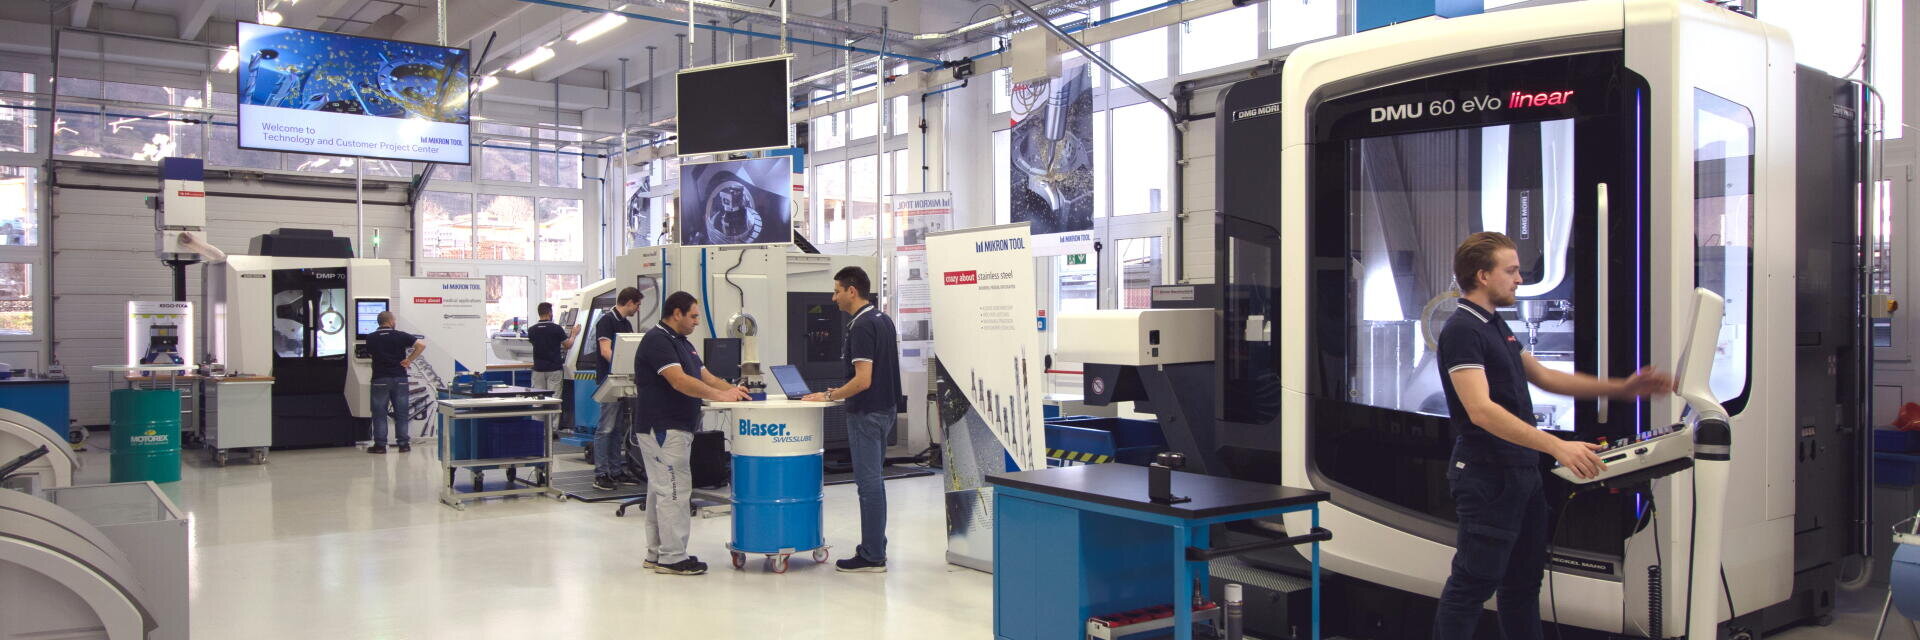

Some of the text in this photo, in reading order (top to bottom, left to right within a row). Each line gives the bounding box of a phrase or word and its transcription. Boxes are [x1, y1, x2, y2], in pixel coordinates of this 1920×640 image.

[1238, 105, 1280, 118] DMG MORI
[1371, 90, 1574, 123] DMU 60 eVo linear
[261, 122, 316, 135] Welcome to
[263, 133, 440, 154] Technology and Customer Project Center
[428, 137, 464, 147] MIKRON TOOL
[984, 237, 1025, 252] MIKRON TOOL
[945, 269, 1014, 284] crazy about stainless steel
[739, 419, 790, 436] Blaser.
